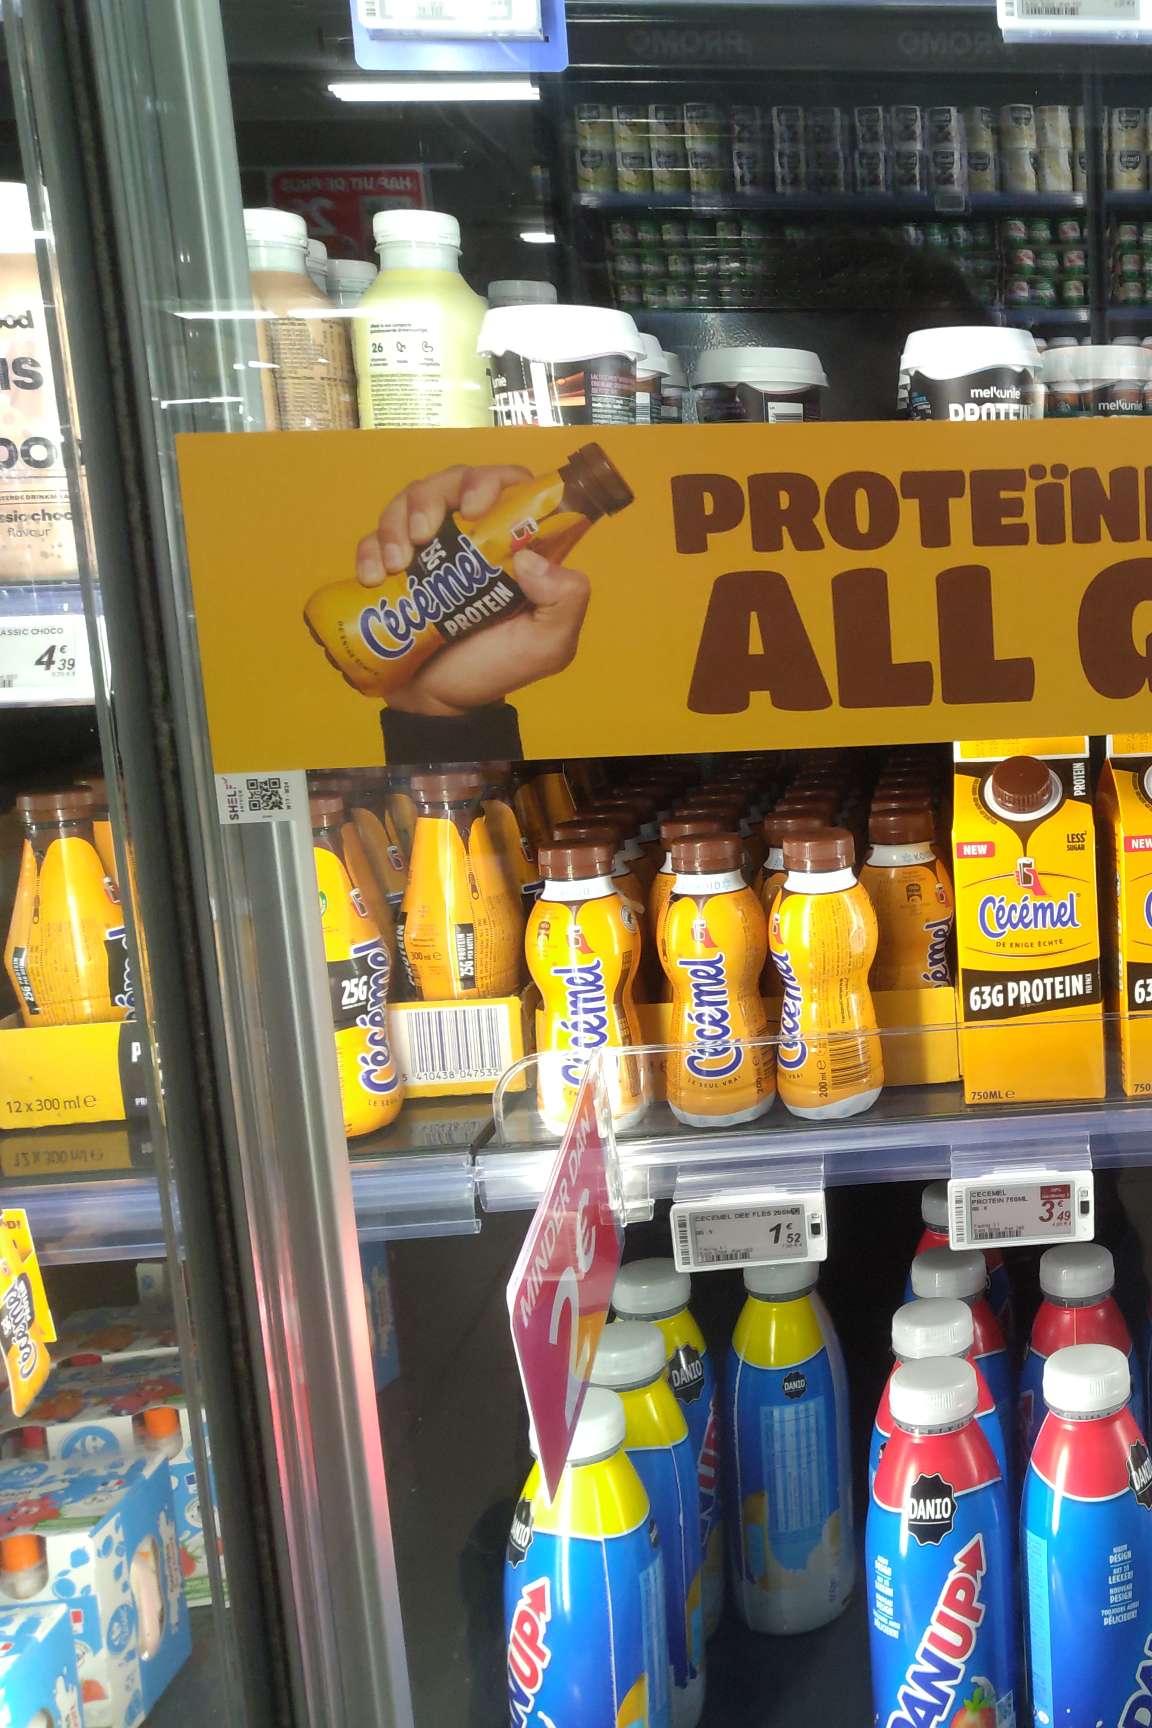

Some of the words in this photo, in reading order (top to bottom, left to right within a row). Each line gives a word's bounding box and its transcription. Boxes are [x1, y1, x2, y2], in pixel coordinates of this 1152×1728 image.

[371, 342, 384, 353] 26
[970, 386, 1021, 399] melkunie
[1098, 400, 1143, 411] melkunie
[8, 527, 51, 538] flavour
[359, 533, 503, 661] Cécémel
[443, 581, 516, 638] PROTEIN
[30, 627, 64, 636] CHOCO
[687, 564, 1035, 716] ALL
[34, 644, 57, 671] 4
[57, 657, 76, 671] 39
[1073, 761, 1086, 797] PROTEIN
[963, 843, 988, 856] NEW
[979, 893, 1081, 938] Cécémel
[1010, 940, 1035, 949] ENIGE
[341, 975, 368, 1002] 25G
[969, 983, 1004, 1012] 63G
[1007, 973, 1084, 1006] PROTEIN
[352, 938, 400, 1094] Cécémel
[552, 957, 609, 1087] Cécémel
[677, 952, 743, 1080] Cécémel
[416, 1069, 456, 1082] 410438
[460, 1067, 499, 1080] 047532
[819, 1081, 830, 1098] 200
[971, 1089, 1004, 1100] 750ML
[6, 1101, 21, 1113] 12
[26, 1103, 34, 1112] x
[37, 1098, 60, 1111] 300
[64, 1096, 80, 1109] ml
[971, 1189, 1007, 1198] CECEMEL
[971, 1197, 1004, 1205] PROTEIN
[518, 1188, 570, 1328] MINDER
[567, 1112, 594, 1178] DAN
[1039, 1200, 1055, 1222] 3
[1057, 1210, 1071, 1221] 49
[769, 1223, 782, 1244] 1
[786, 1232, 801, 1243] 52
[671, 1357, 705, 1390] DANIO
[782, 1377, 807, 1391] DANIO
[908, 1496, 951, 1520] DANIO
